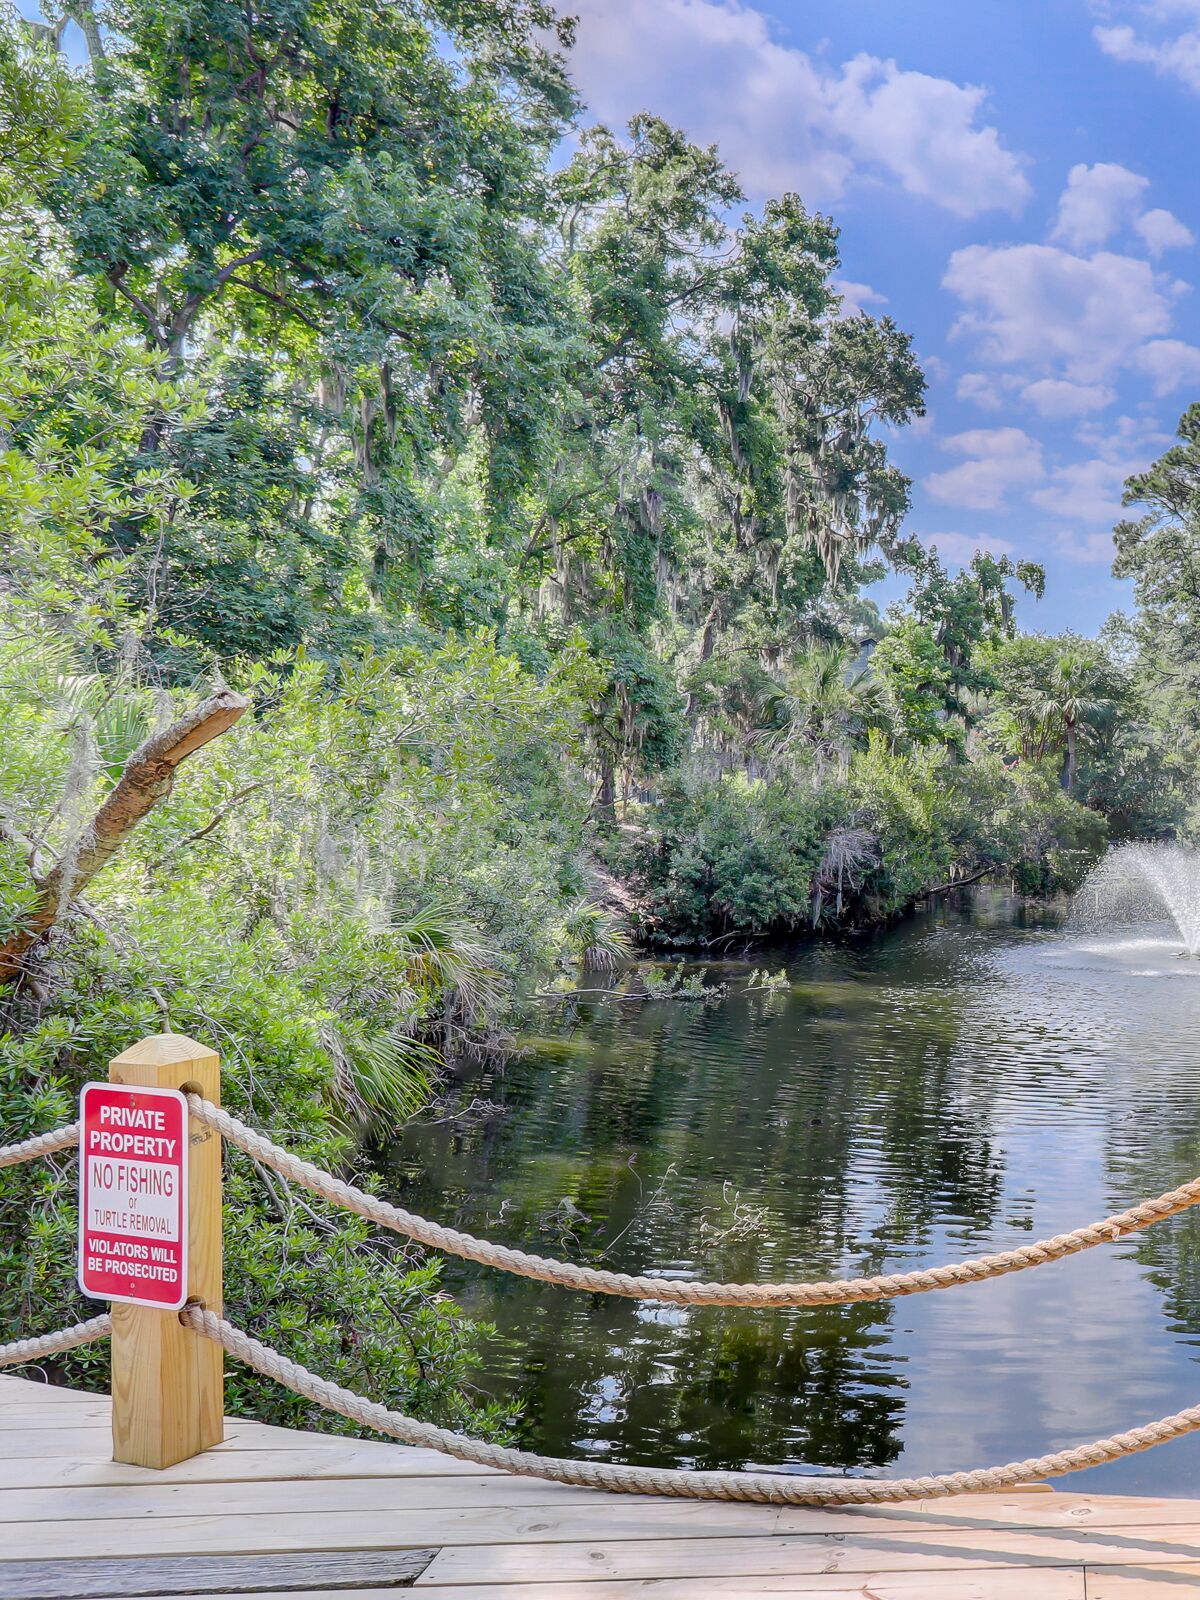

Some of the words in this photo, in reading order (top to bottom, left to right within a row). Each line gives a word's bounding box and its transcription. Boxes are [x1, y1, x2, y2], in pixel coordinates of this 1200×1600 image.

[100, 1105, 166, 1130] PRIVATE
[90, 1130, 176, 1158] PROPERTY
[94, 1162, 112, 1190] NO
[118, 1165, 173, 1198] FISHING
[128, 1196, 137, 1209] or
[94, 1209, 126, 1228] TURTLE
[130, 1214, 172, 1235] REMOVAL
[89, 1238, 148, 1259] VIOLATORS
[151, 1248, 177, 1264] WILL
[88, 1258, 103, 1272] BE
[105, 1260, 178, 1283] PROSECUTED
